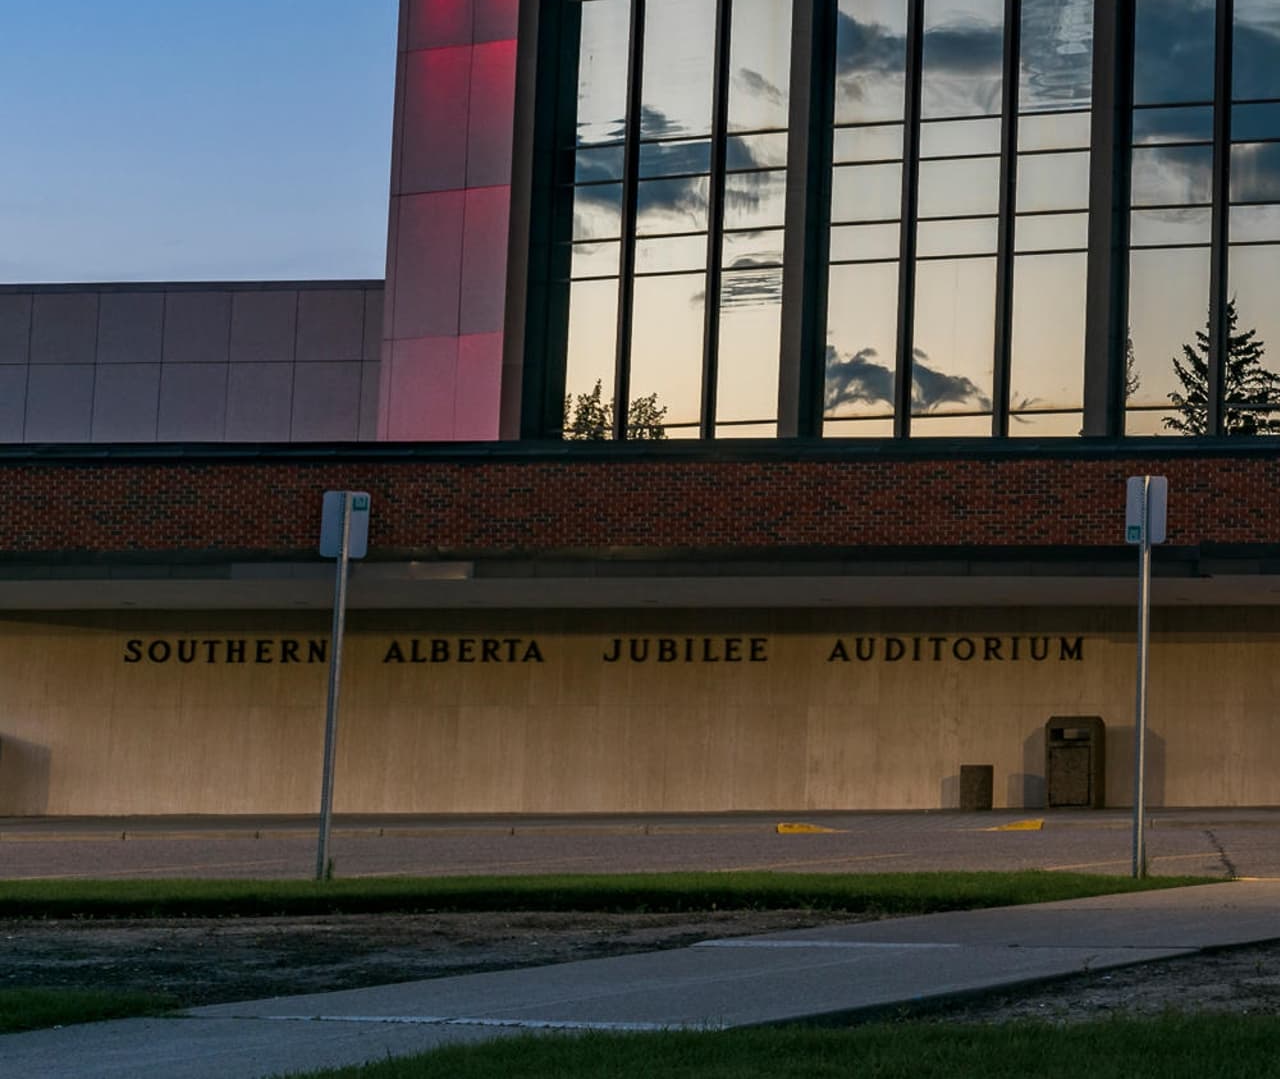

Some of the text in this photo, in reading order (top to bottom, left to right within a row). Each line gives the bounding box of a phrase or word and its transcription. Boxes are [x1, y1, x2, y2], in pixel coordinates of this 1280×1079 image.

[124, 637, 1084, 663] SOUTHERN ALBERTA JUBILEE AUDITORIUM
